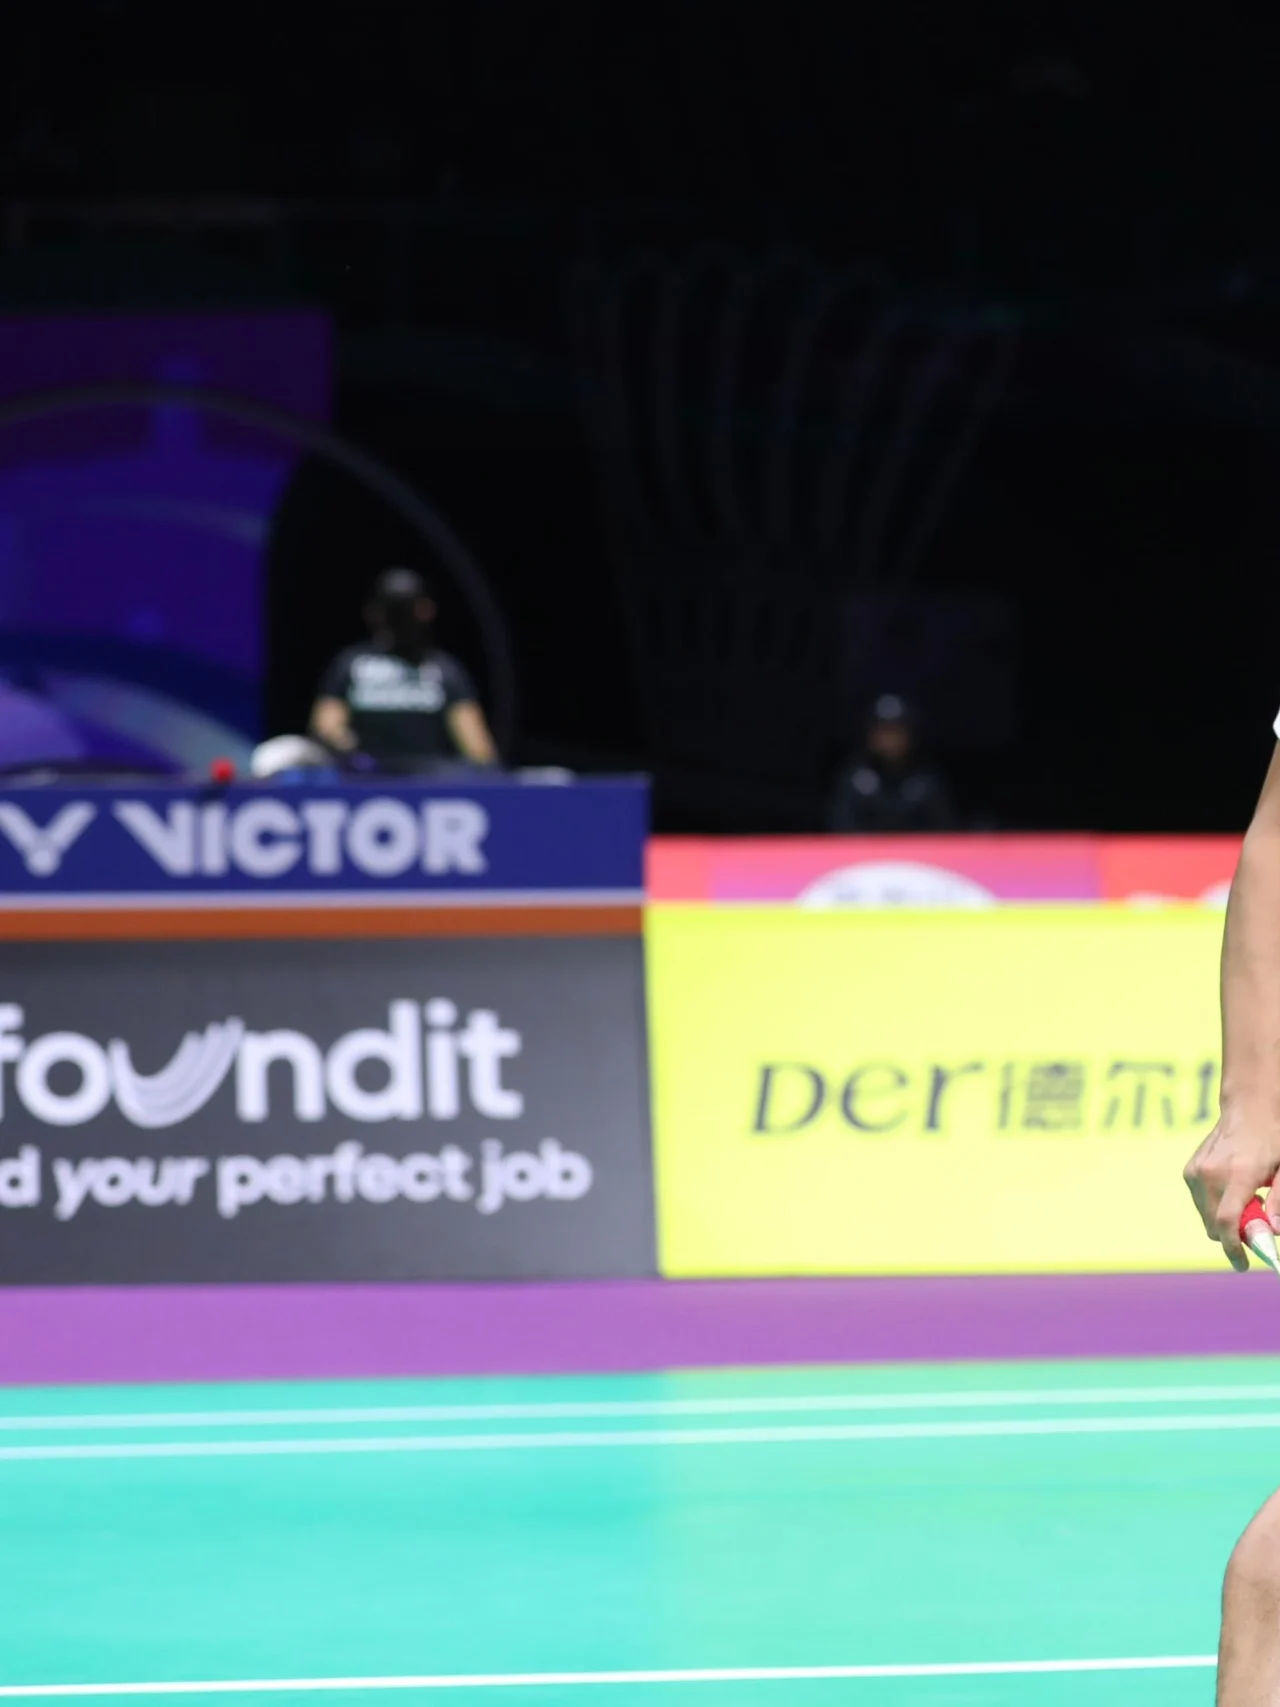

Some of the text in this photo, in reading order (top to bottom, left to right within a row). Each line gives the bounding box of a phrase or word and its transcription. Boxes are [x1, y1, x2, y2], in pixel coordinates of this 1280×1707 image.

[115, 800, 488, 876] VICTOR
[55, 1157, 208, 1220] your
[217, 1142, 472, 1217] perfect
[478, 1139, 592, 1213] job
